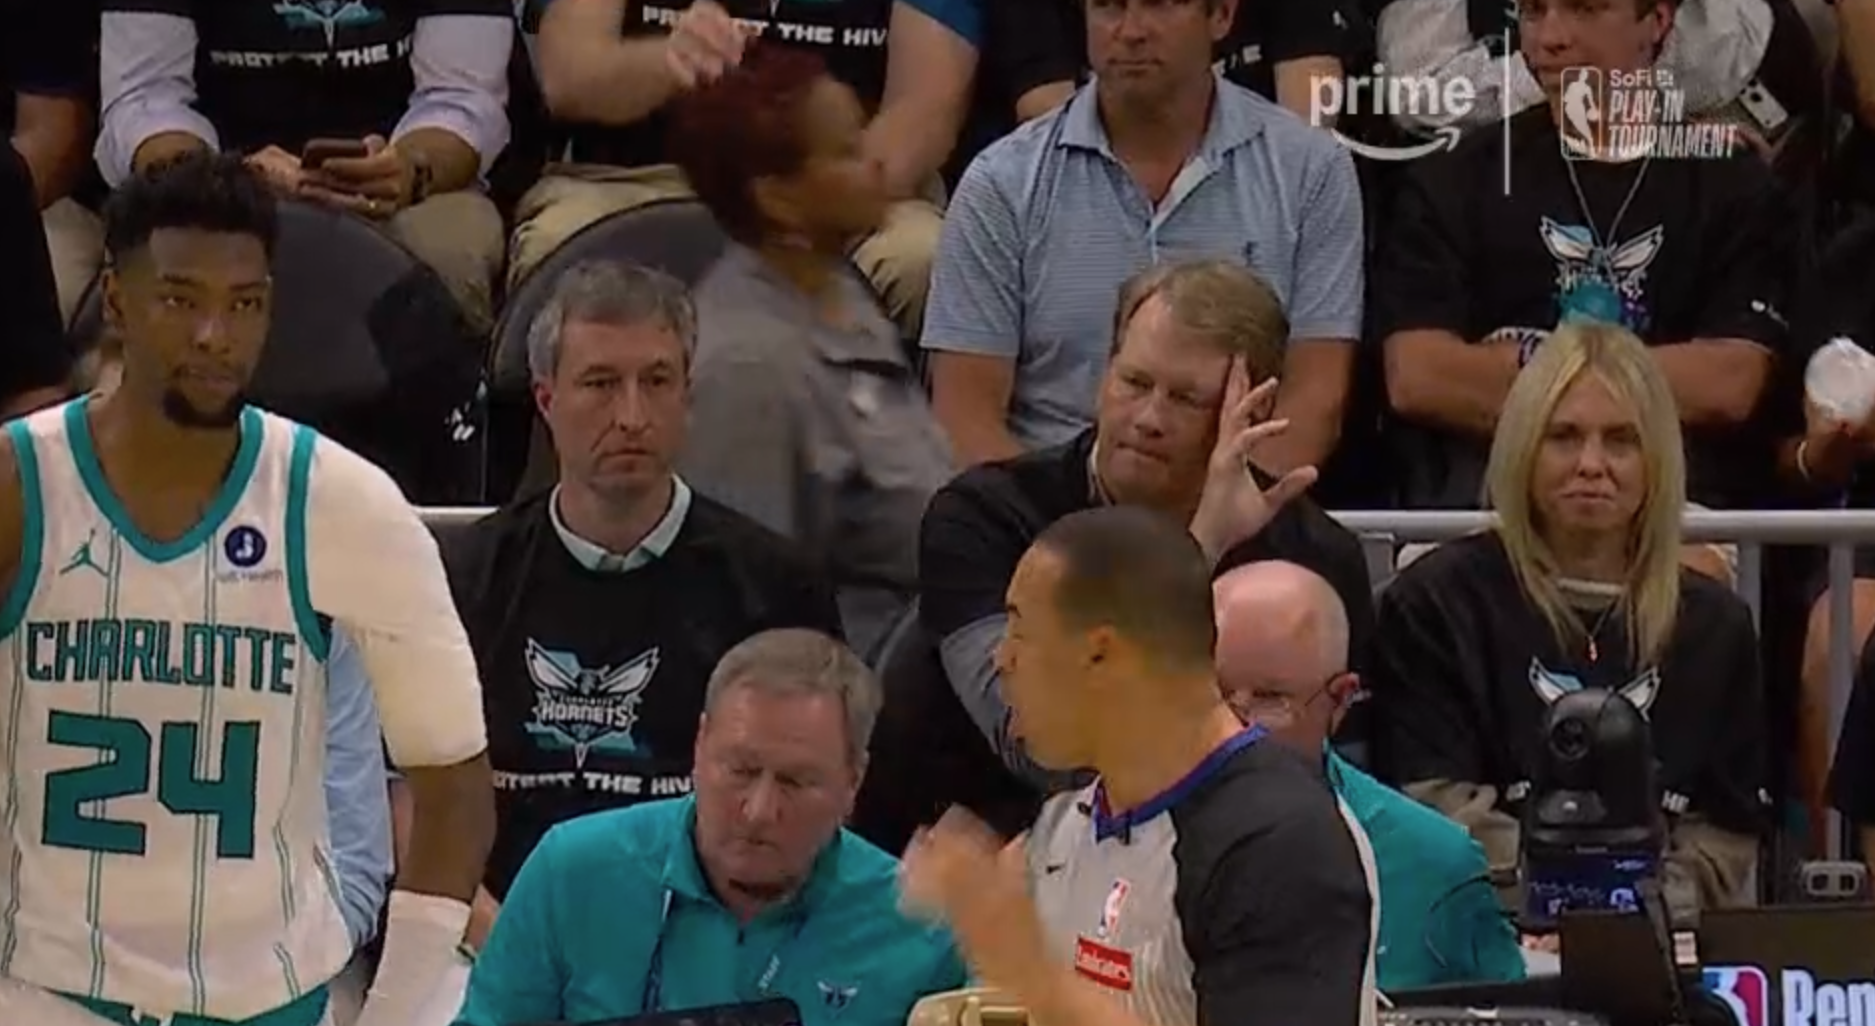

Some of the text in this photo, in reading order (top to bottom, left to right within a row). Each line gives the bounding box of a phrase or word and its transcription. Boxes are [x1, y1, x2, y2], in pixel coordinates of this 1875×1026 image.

[778, 22, 834, 44] THE
[336, 43, 389, 67] THE
[26, 617, 296, 695] CHARLOTTE
[539, 699, 629, 729] HORNETS
[41, 708, 261, 859] 24
[583, 770, 643, 795] THE
